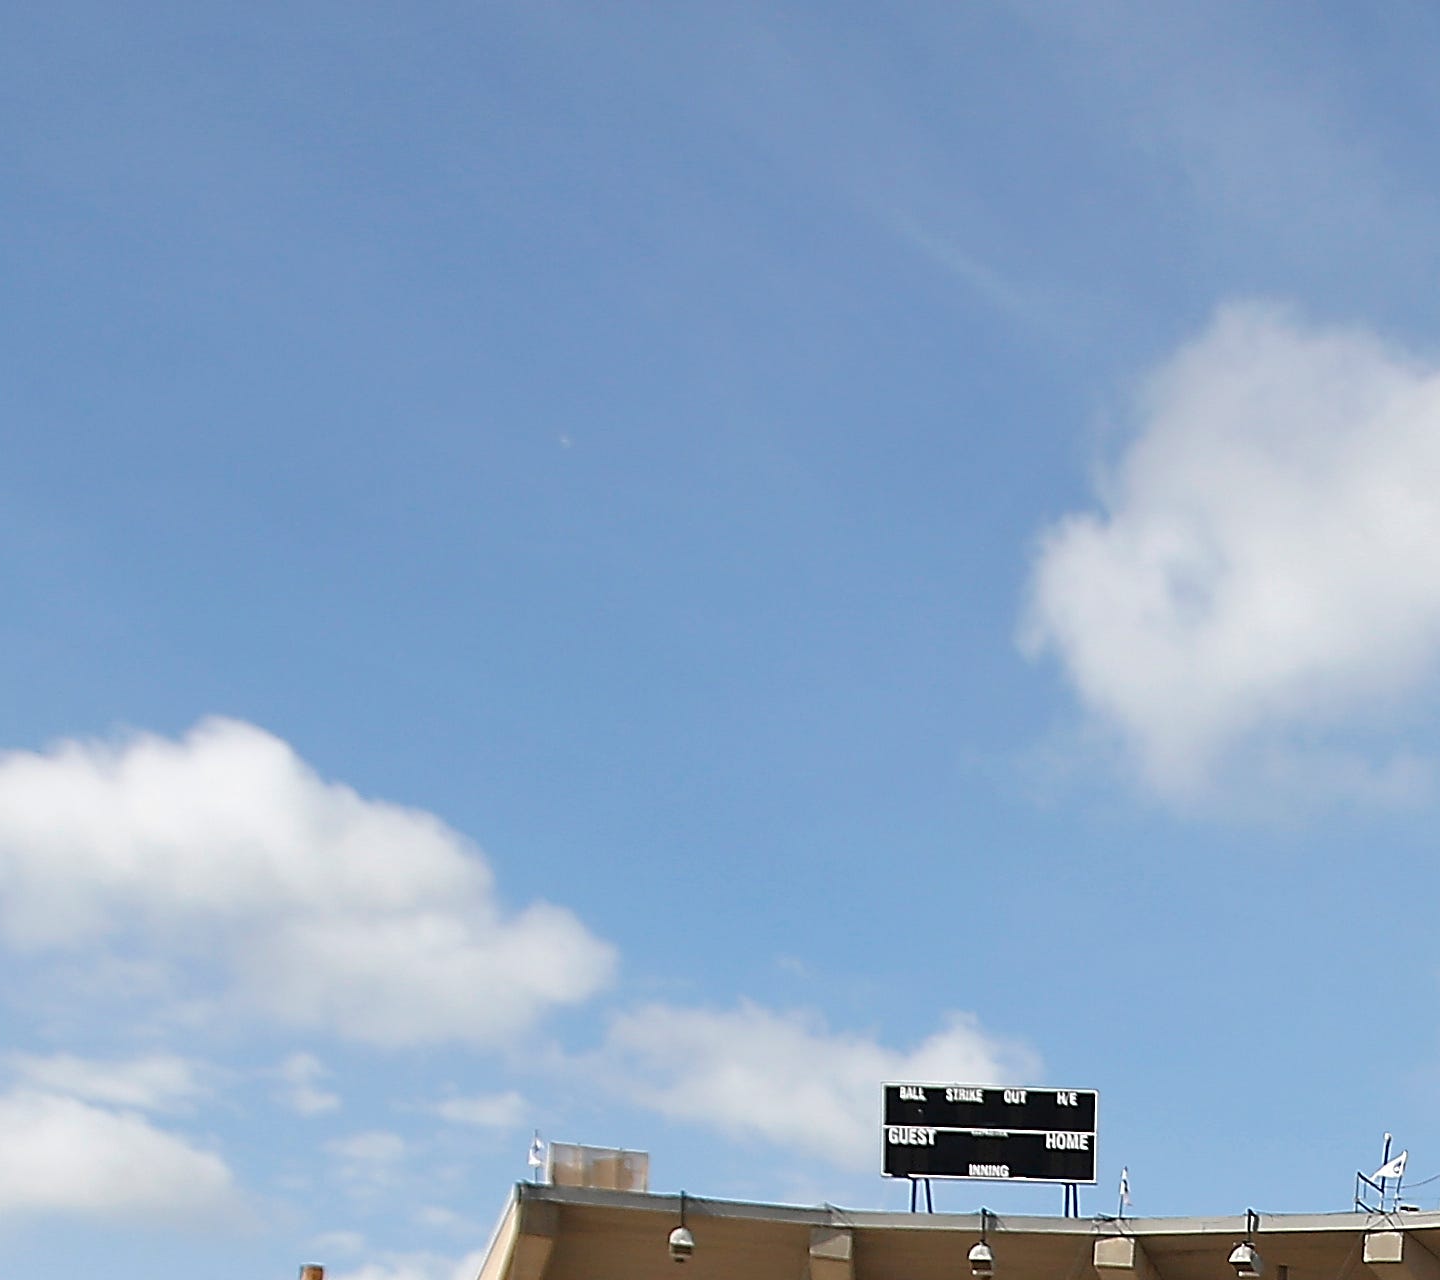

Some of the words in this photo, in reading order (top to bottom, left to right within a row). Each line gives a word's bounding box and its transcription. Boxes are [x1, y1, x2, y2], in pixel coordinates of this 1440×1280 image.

[899, 1087, 926, 1101] BALL
[946, 1088, 984, 1103] STRIKE
[1004, 1090, 1027, 1104] OUT
[1057, 1091, 1078, 1106] H/E
[888, 1128, 937, 1145] GUEST
[1046, 1133, 1089, 1150] HOME
[968, 1164, 1009, 1177] INNING
